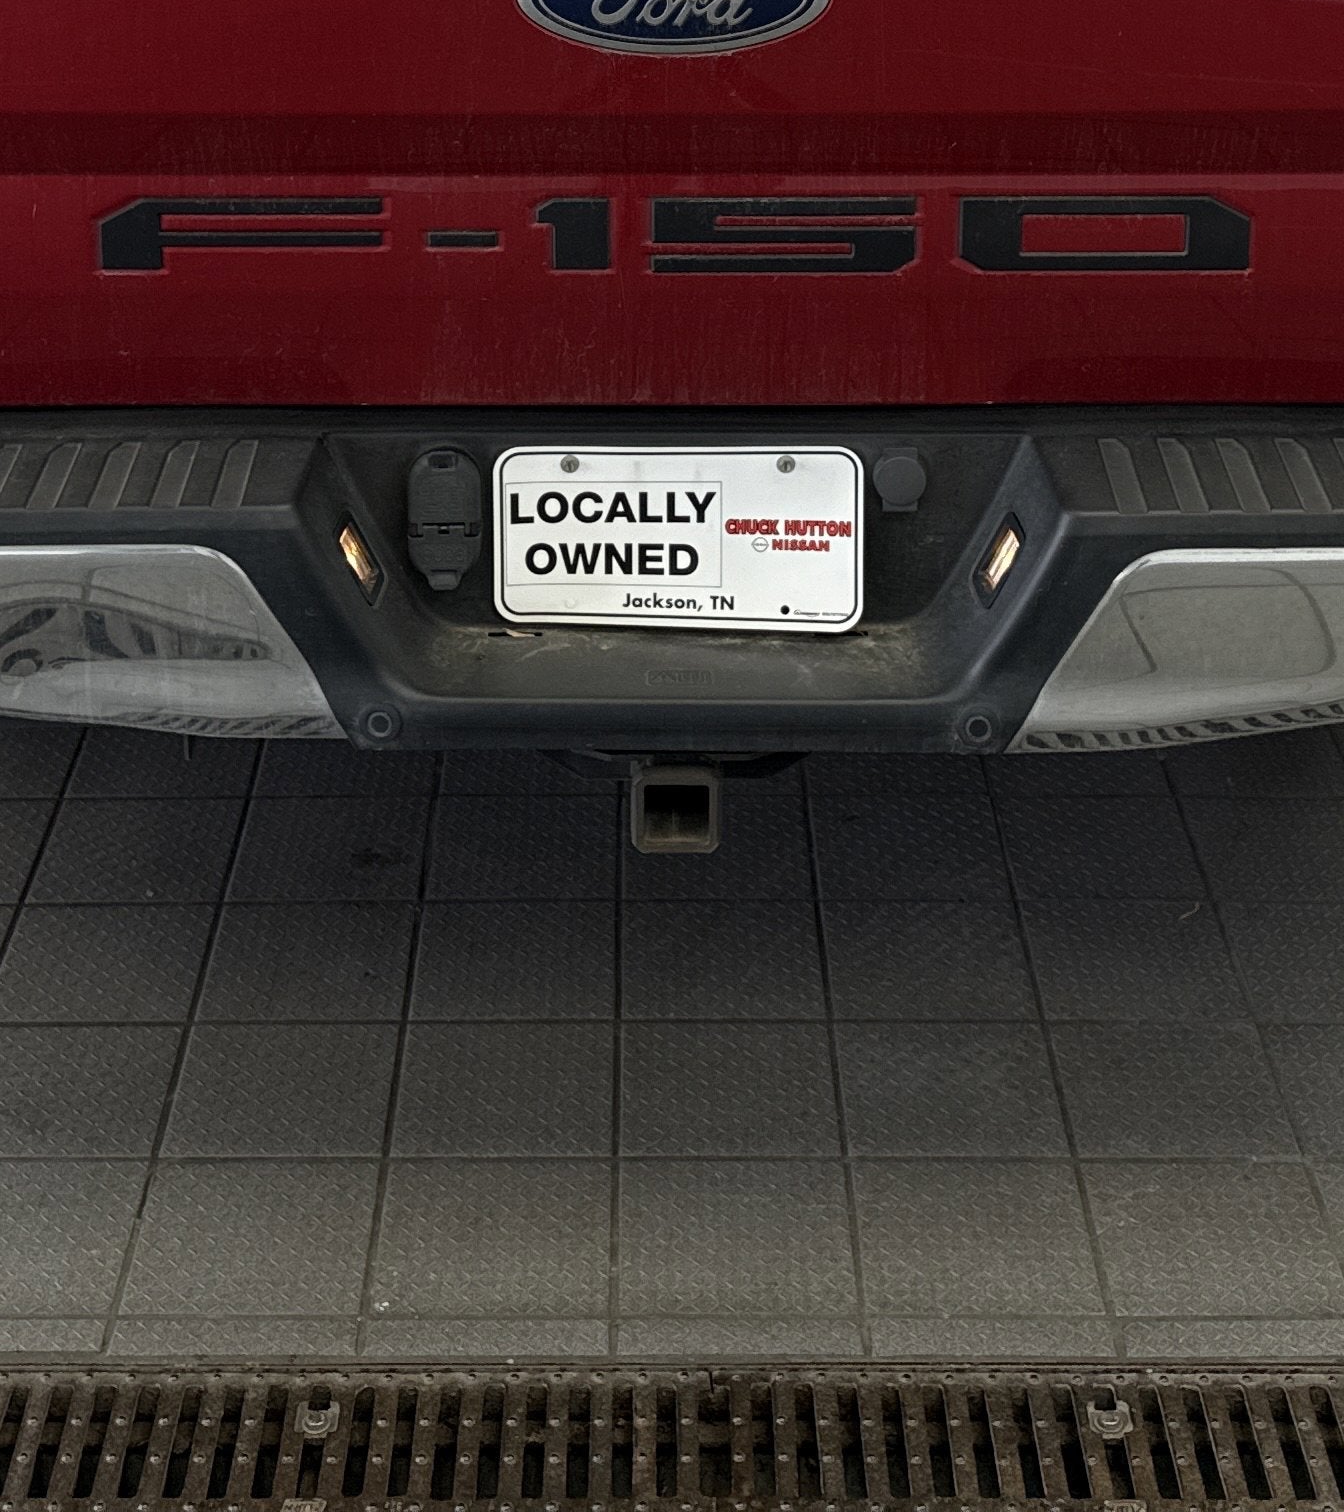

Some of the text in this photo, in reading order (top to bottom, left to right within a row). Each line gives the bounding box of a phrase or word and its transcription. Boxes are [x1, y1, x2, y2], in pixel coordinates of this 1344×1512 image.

[97, 194, 1254, 274] F-150
[510, 491, 717, 524] LOCALLY
[725, 518, 852, 537] CHUCK HUTTON
[772, 539, 830, 551] NISSAN
[525, 543, 699, 575] OWNED
[622, 593, 735, 611] Jackson, TN
